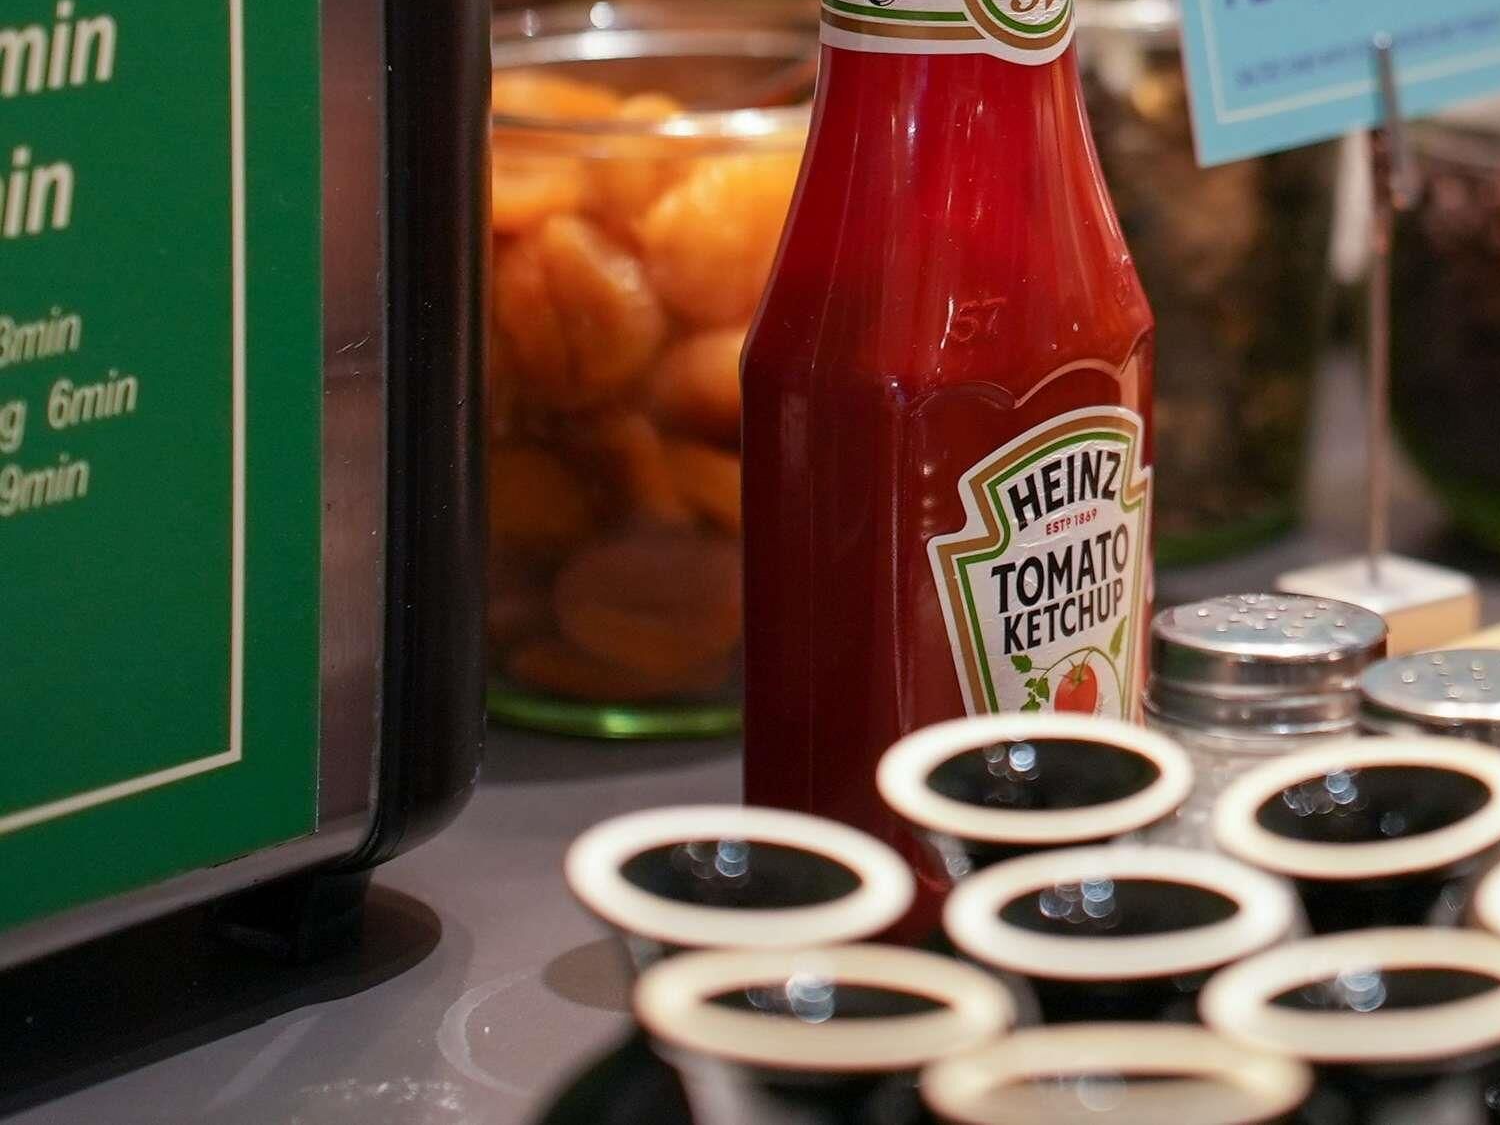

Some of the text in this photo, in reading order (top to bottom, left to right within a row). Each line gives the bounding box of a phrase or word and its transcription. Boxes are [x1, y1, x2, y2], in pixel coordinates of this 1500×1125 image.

[48, 369, 138, 431] 6min
[0, 455, 90, 517] 9min
[1007, 450, 1121, 532] HEINZ
[1074, 507, 1098, 527] 1869
[991, 521, 1130, 614] TOMATO
[1002, 577, 1125, 655] KETCHUP
